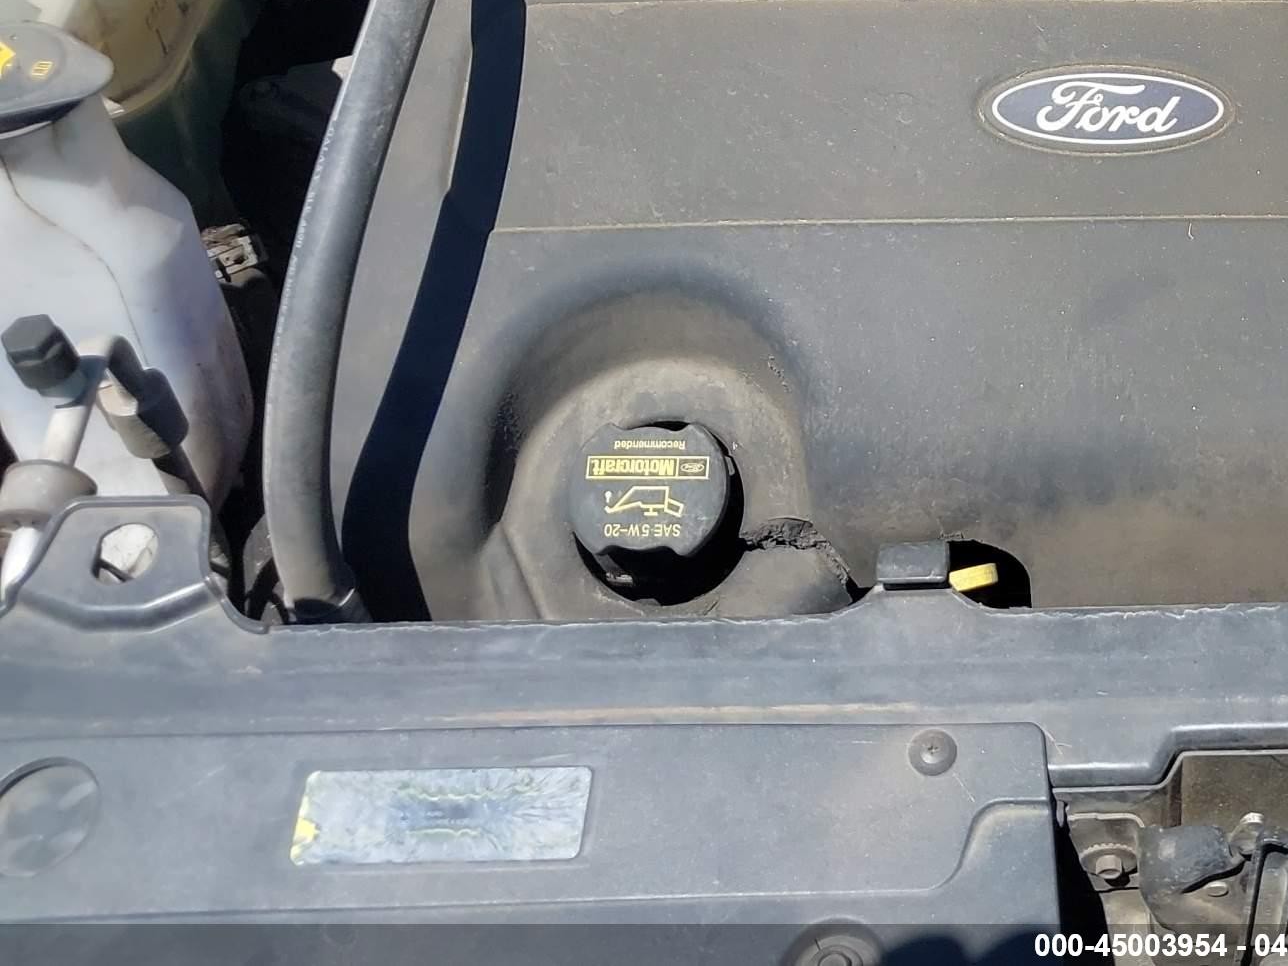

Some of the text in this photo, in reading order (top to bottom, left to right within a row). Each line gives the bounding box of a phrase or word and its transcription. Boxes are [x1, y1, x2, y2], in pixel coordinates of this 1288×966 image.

[1036, 80, 1181, 133] Ford
[613, 439, 687, 450] Recommended
[591, 458, 675, 476] Motorcraft
[654, 523, 682, 537] SAE
